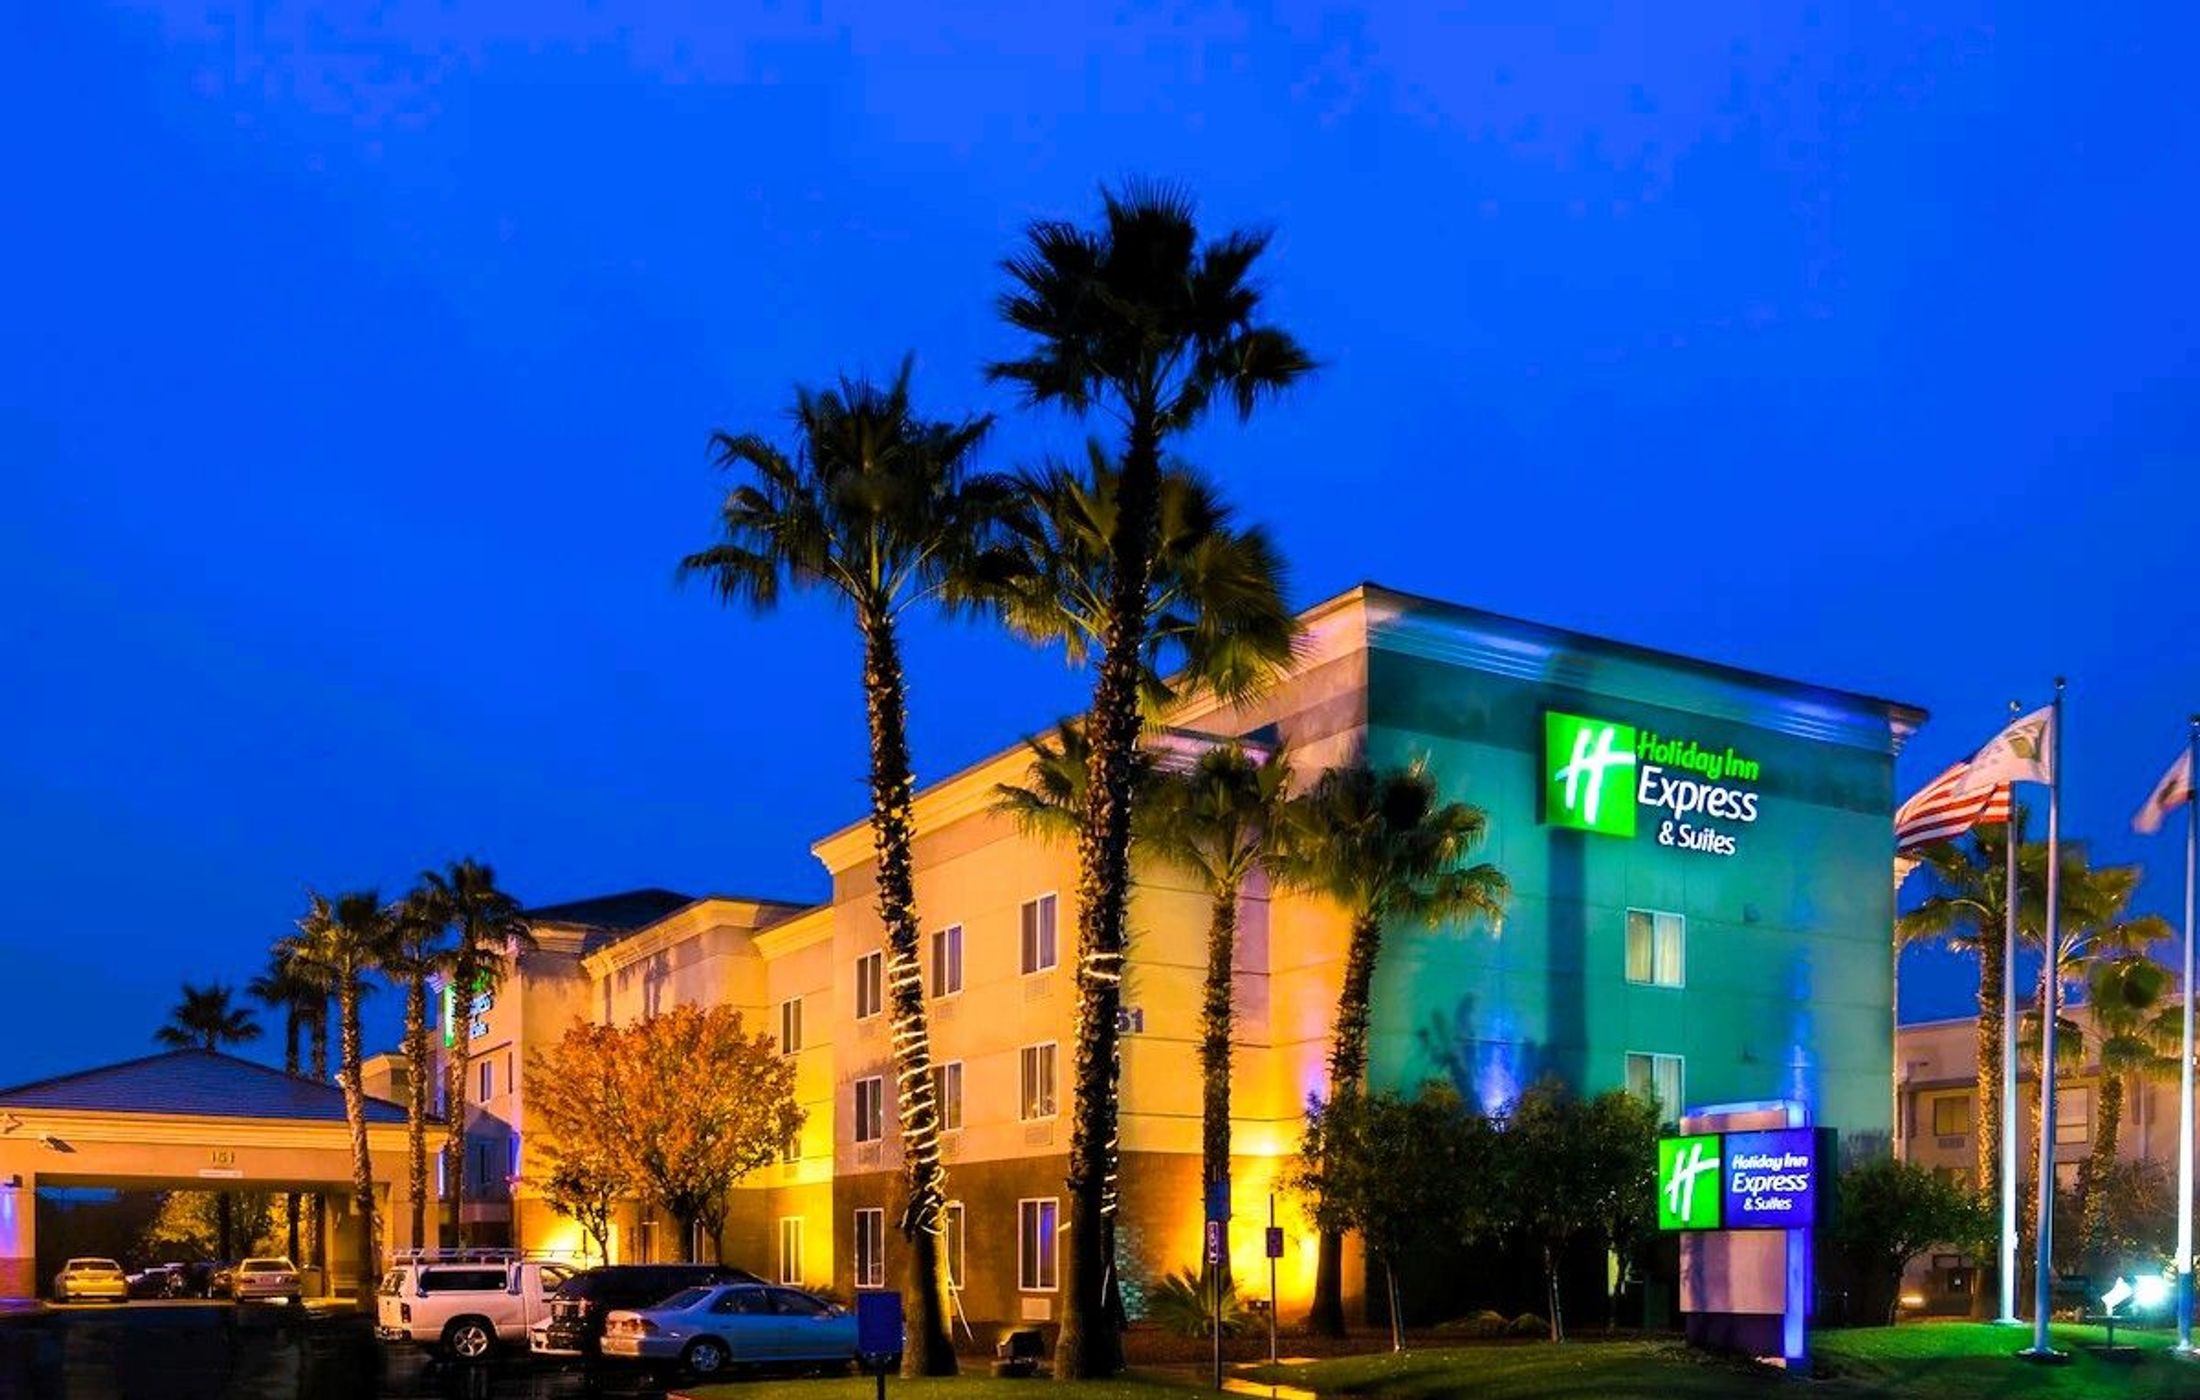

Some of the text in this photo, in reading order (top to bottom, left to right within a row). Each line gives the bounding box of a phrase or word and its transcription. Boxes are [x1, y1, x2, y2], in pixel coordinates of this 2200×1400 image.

[1637, 731, 1759, 781] Holiday Inn
[1637, 765, 1759, 822] Express
[1658, 820, 1736, 856] & Suites
[1732, 1152, 1809, 1171] Holiday Inn
[1732, 1172, 1809, 1196] Express
[1743, 1197, 1792, 1211] & Suites
